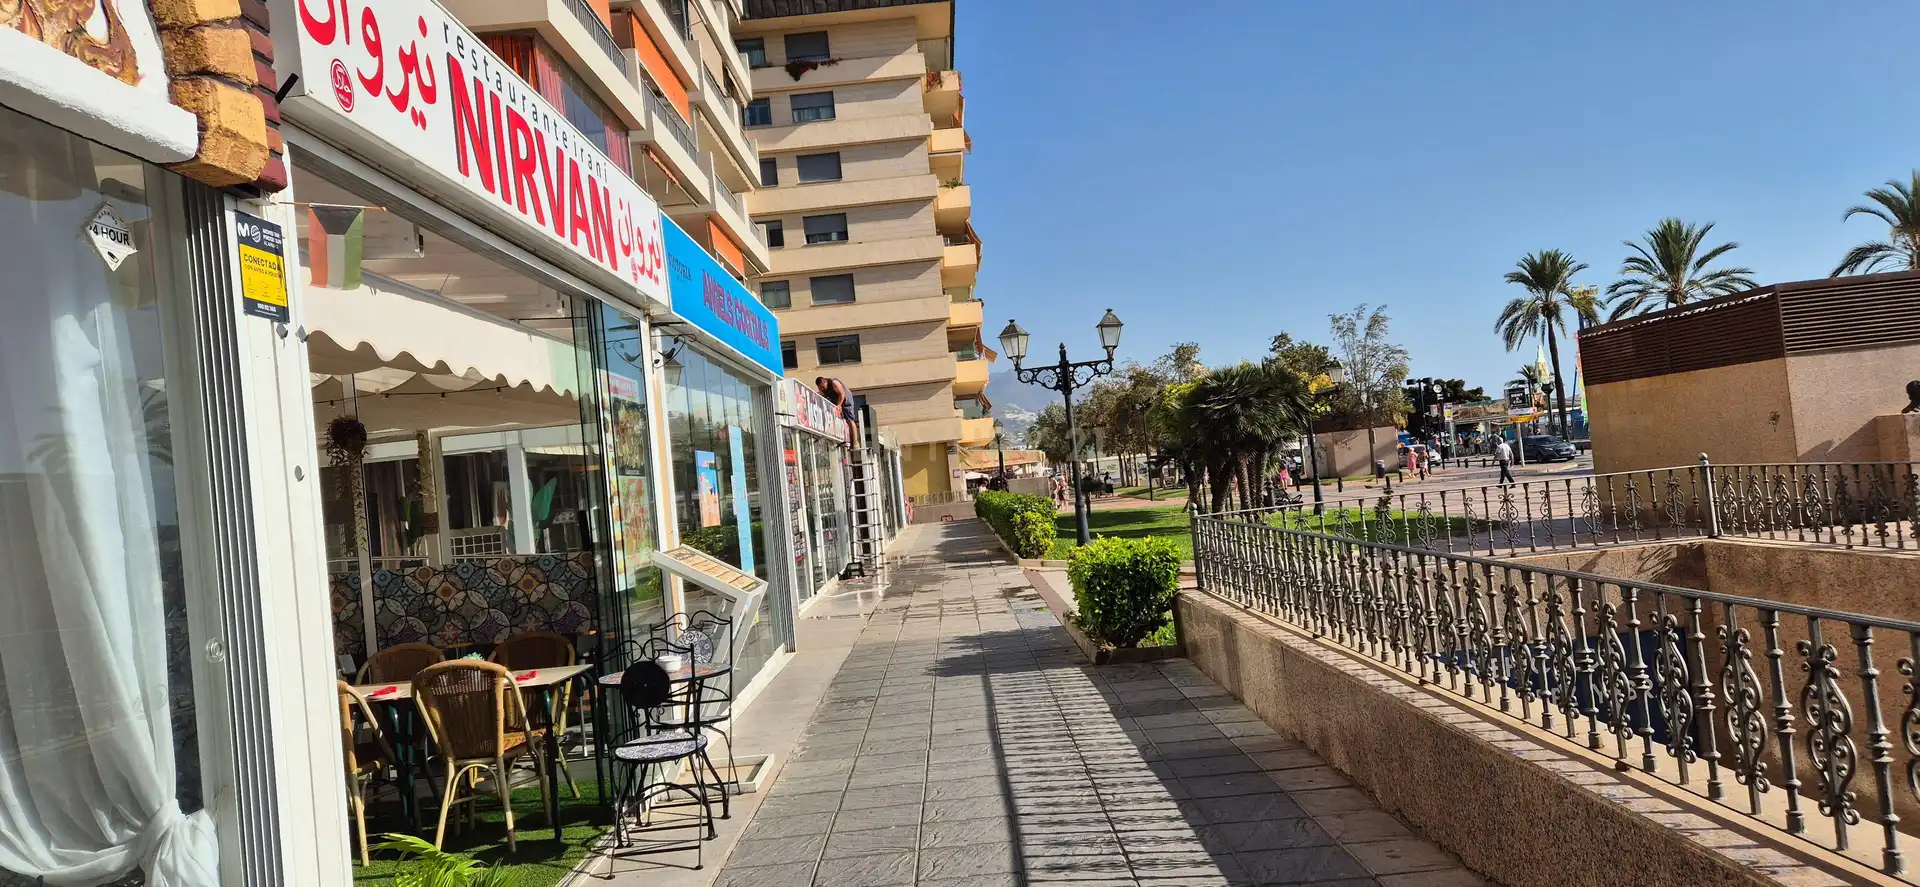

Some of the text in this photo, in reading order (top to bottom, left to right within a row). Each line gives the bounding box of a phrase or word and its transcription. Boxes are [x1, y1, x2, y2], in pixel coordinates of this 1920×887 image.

[447, 52, 618, 271] NIRVAN
[100, 226, 130, 246] HOUR
[243, 253, 281, 271] CONECTADA
[702, 269, 734, 328] ANGELS
